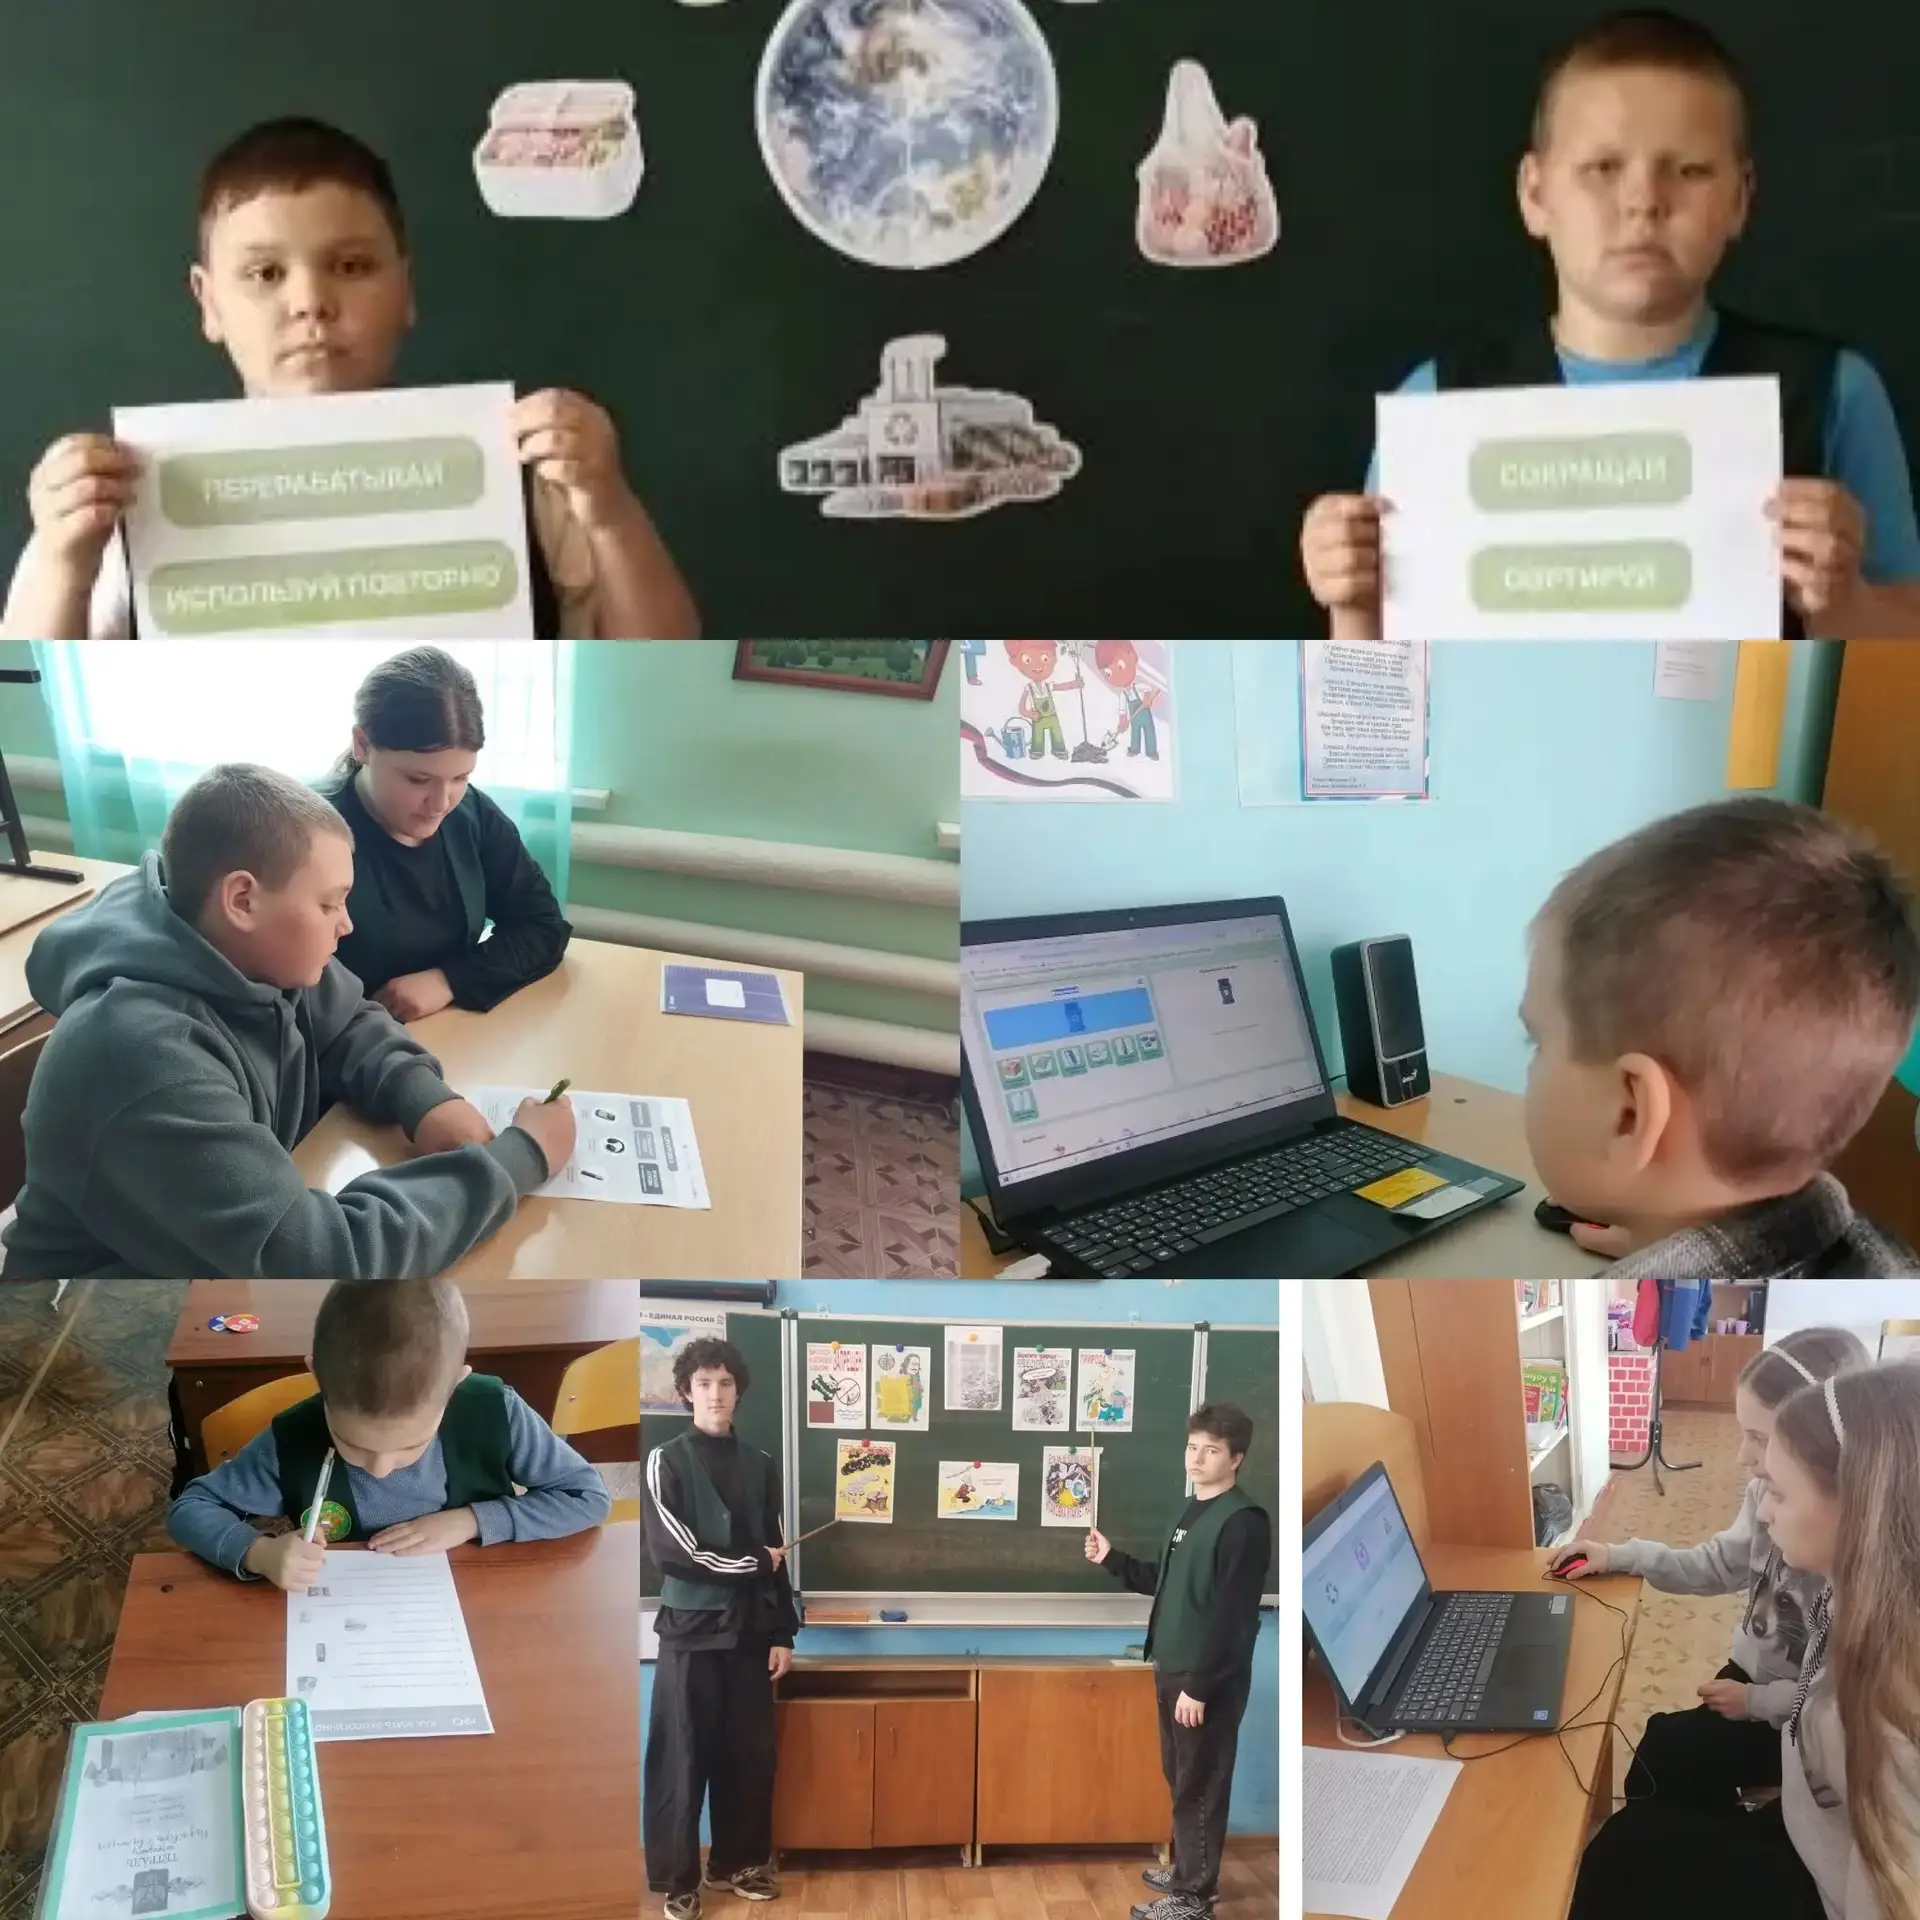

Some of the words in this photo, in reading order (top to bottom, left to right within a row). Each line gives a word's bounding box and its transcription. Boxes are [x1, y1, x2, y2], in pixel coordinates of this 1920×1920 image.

[204, 461, 443, 502] ПЕРЕРАБАТЫВАЙ
[1500, 454, 1667, 487] СОКРАЩАЙ
[166, 572, 341, 612] ИСПОЛЬЗУЙ
[349, 563, 501, 596] ПОВТОРНО
[1504, 562, 1656, 591] СОРТИРУЙ
[649, 1312, 683, 1321] ЕДИНАЯ
[684, 1315, 715, 1323] РОССИЯ
